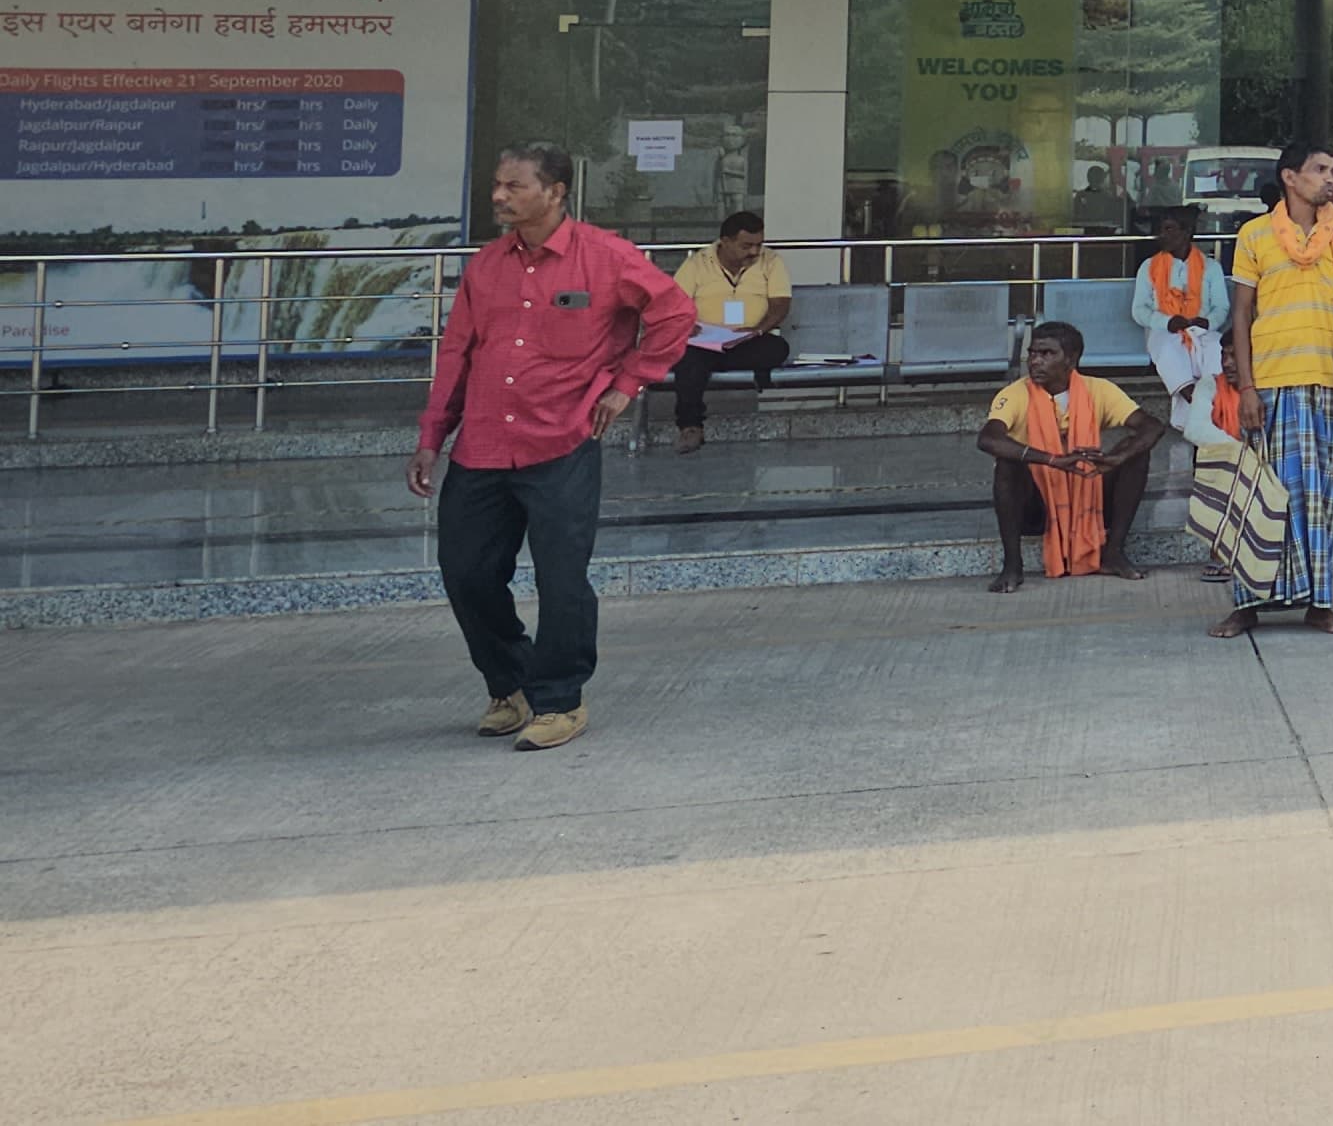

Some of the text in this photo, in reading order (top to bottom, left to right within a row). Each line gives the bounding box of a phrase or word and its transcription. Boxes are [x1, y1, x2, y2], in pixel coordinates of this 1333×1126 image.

[58, 12, 115, 38] एयर
[126, 7, 203, 35] बनेगा
[214, 8, 278, 39] हवाई
[287, 13, 395, 38] हमसफर
[916, 57, 1065, 77] WELCOMES
[43, 73, 98, 91] Flights
[103, 73, 173, 88] Effective
[209, 73, 299, 90] September
[304, 74, 344, 88] 2020
[960, 83, 1019, 102] YOU
[20, 97, 177, 113] Hyderabad/Jagdalpur
[299, 98, 324, 111] hrs
[343, 97, 380, 112] Daily
[17, 118, 144, 134] Jagdalpur/Raipur
[299, 118, 323, 131] hrs
[343, 118, 379, 133] Daily
[18, 138, 143, 154] Raipur/Jagdalpur
[298, 139, 322, 151] hrs
[342, 138, 378, 153] Daily
[15, 159, 175, 174] Jagdalpur/Hyderabad
[297, 159, 321, 172] hrs
[341, 158, 377, 173] Daily
